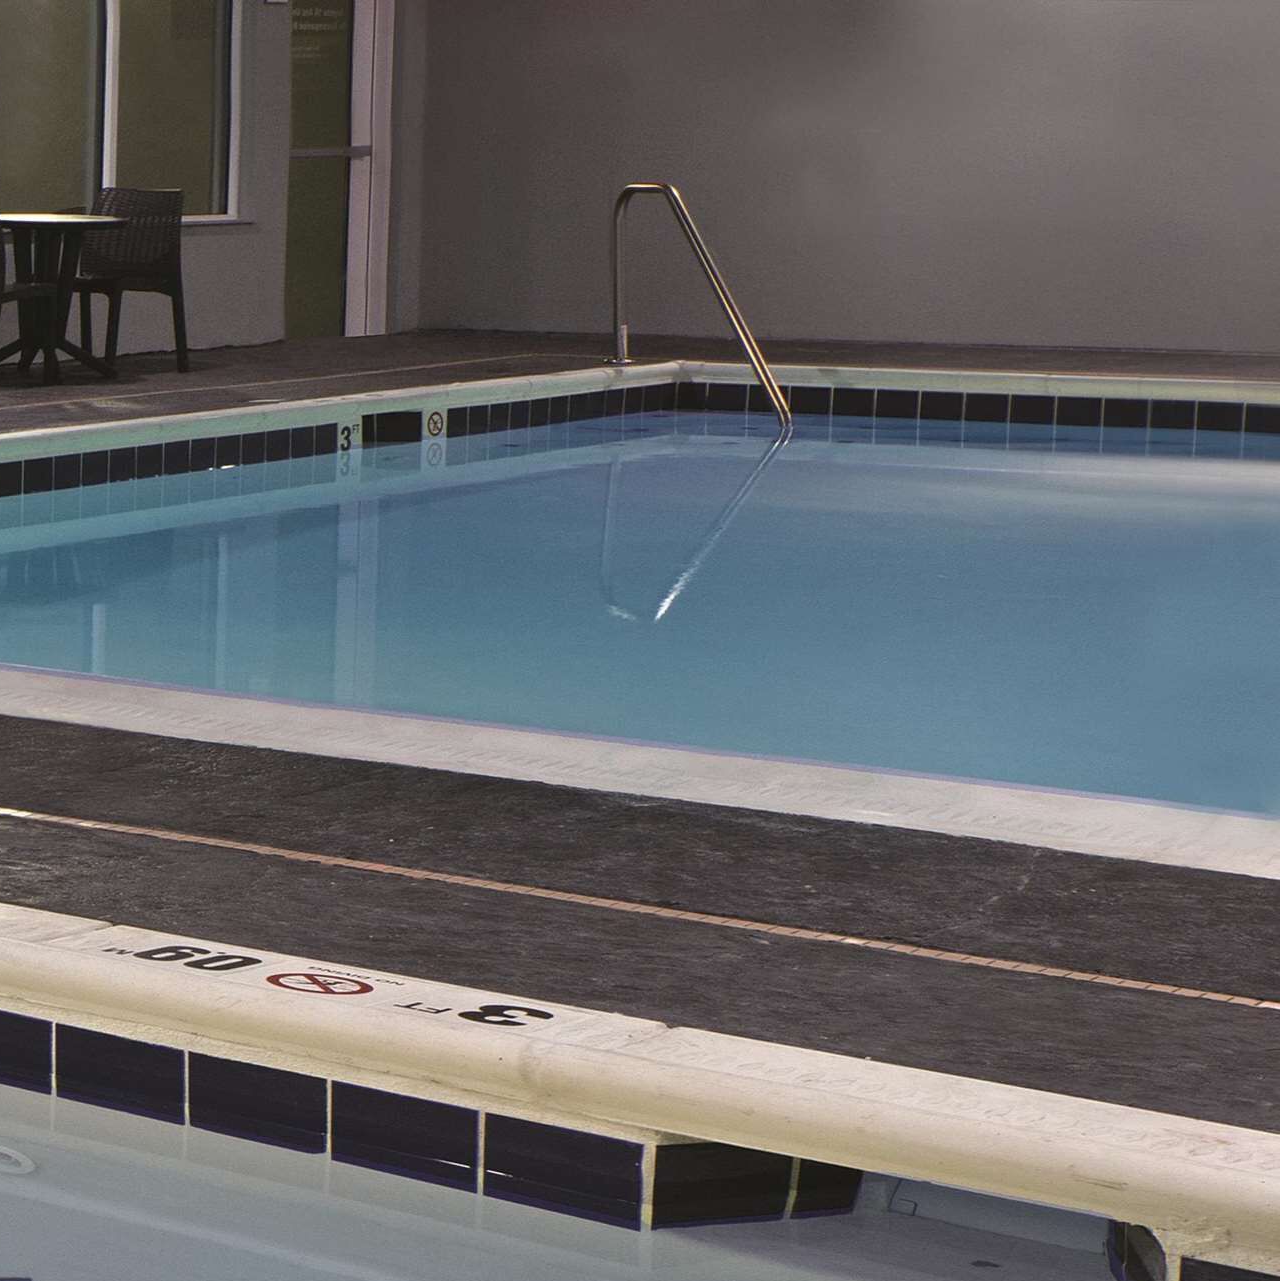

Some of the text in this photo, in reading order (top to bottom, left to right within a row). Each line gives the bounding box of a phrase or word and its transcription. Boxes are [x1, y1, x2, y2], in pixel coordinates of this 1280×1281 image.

[341, 426, 351, 451] 3
[101, 944, 263, 971] 0.9 M
[374, 978, 405, 987] NO
[392, 1002, 554, 1027] 3 FT
